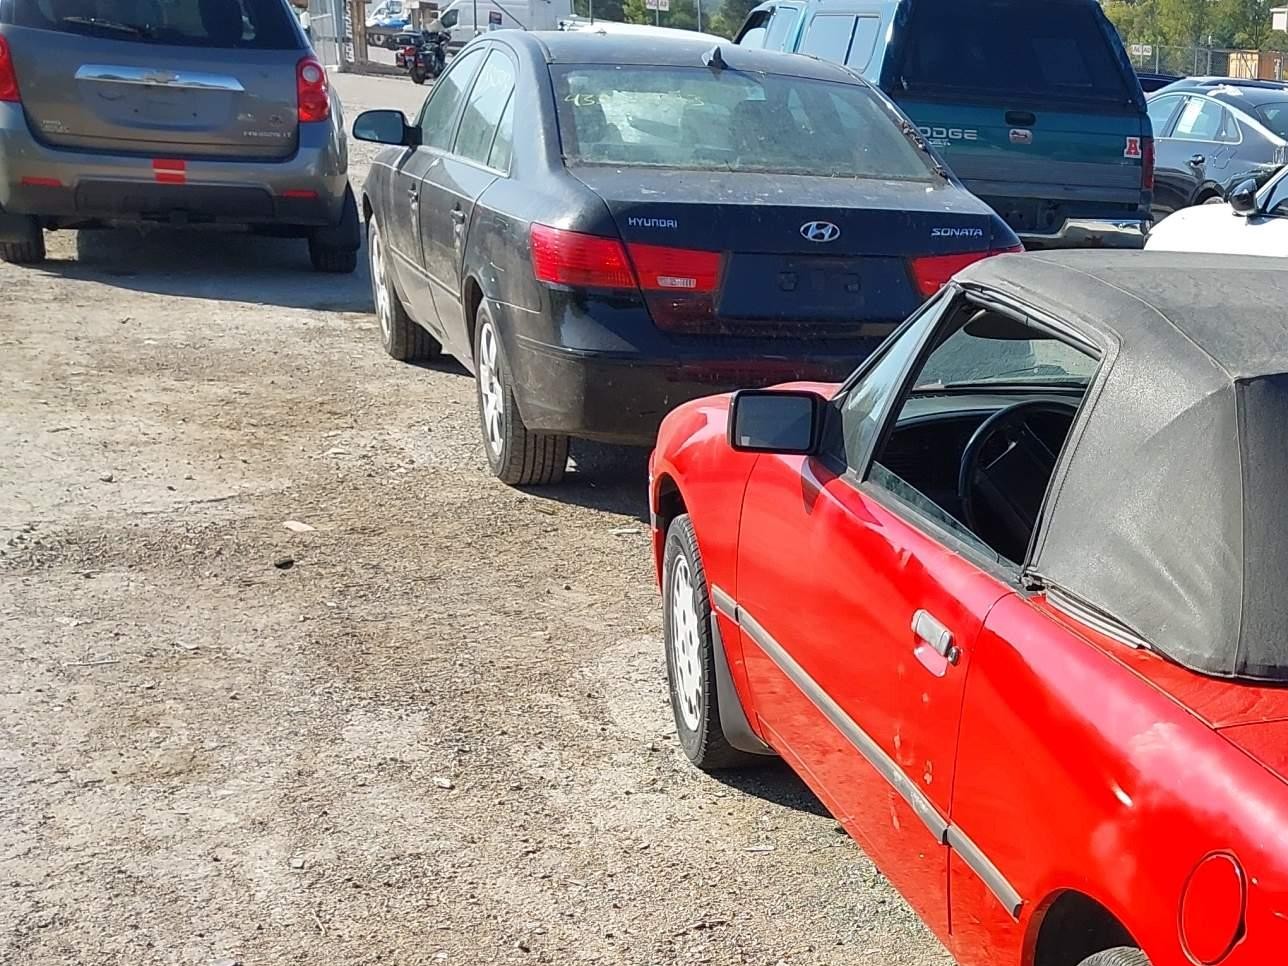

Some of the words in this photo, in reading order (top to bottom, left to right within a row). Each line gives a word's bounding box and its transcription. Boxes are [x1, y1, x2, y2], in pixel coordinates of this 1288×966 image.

[918, 126, 978, 140] ODGE
[628, 217, 678, 228] HYUNDAI
[931, 228, 983, 236] SONATA
